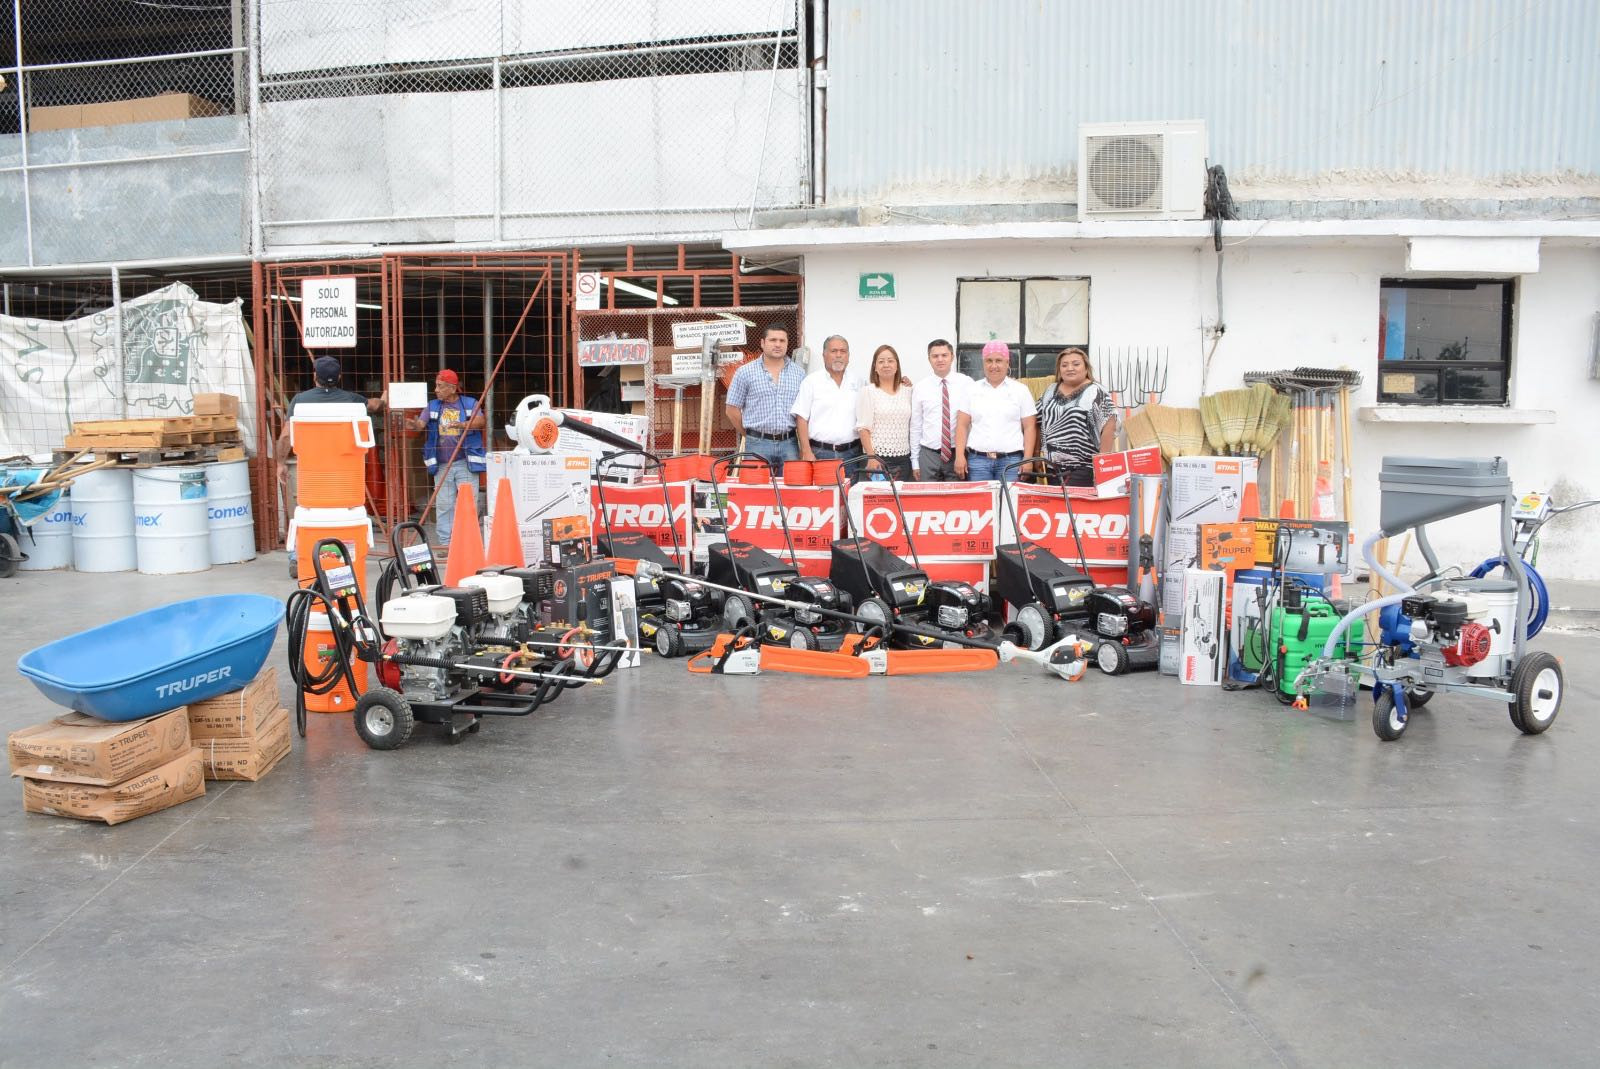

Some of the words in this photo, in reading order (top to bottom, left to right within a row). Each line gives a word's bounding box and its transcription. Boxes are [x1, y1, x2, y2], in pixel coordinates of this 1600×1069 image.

[318, 287, 340, 299] SOLO
[310, 306, 348, 318] PERSONAL
[305, 326, 355, 338] AUTORIZADO
[207, 503, 249, 520] Comex
[135, 512, 163, 526] mex
[1053, 513, 1129, 539] TRO
[808, 536, 817, 544] 12
[981, 541, 989, 549] 11
[1221, 546, 1252, 554] RUPER
[587, 570, 612, 583] TRUPER
[155, 665, 232, 699] TRUPER
[118, 729, 150, 747] TRUPER
[125, 775, 161, 793] TRUPER
